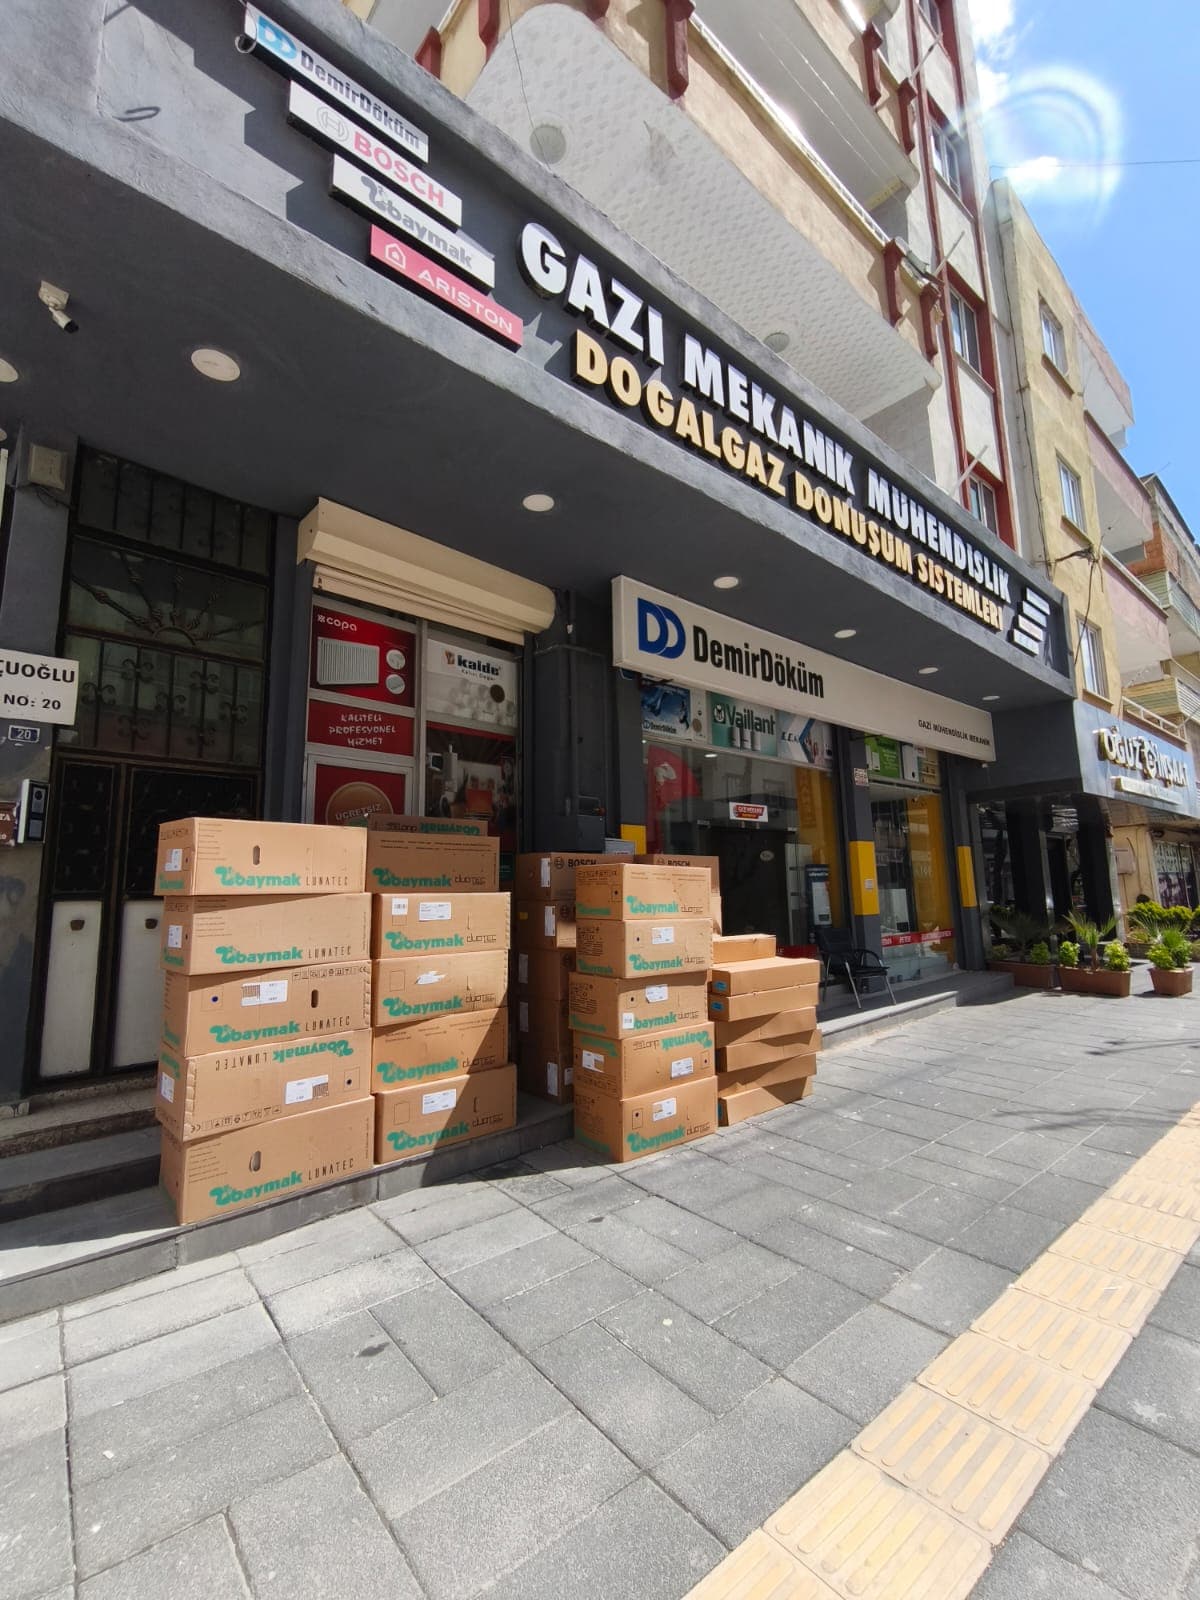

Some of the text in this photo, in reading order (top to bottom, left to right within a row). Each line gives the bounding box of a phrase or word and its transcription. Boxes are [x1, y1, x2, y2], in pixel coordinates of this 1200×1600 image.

[301, 50, 421, 150] DemirDöküm
[354, 131, 444, 208] BOSCH
[386, 198, 472, 270] baymak
[417, 268, 512, 334] ARISTON
[326, 616, 357, 632] copa
[457, 654, 499, 676] kalde
[693, 625, 825, 698] DemirDöküm
[3, 693, 61, 710] NO: 20
[328, 725, 396, 735] PROFESYONEL
[725, 705, 776, 735] Vaillant
[17, 728, 31, 740] 20
[235, 873, 348, 889] baymak LUNATEC
[392, 873, 452, 889] baymak
[639, 901, 679, 915] baymak
[402, 933, 465, 950] baymak
[236, 946, 351, 964] baymak LUNATEC
[641, 956, 683, 971] baymak
[402, 995, 463, 1015] baymak
[230, 1015, 350, 1041] baymak LUNATEC
[215, 1040, 336, 1072] baymak LUNATEC
[394, 1056, 459, 1081] baymak
[403, 1121, 470, 1148] baymak
[640, 1124, 685, 1150] baymak
[230, 1157, 354, 1202] baymak LUNATEC
